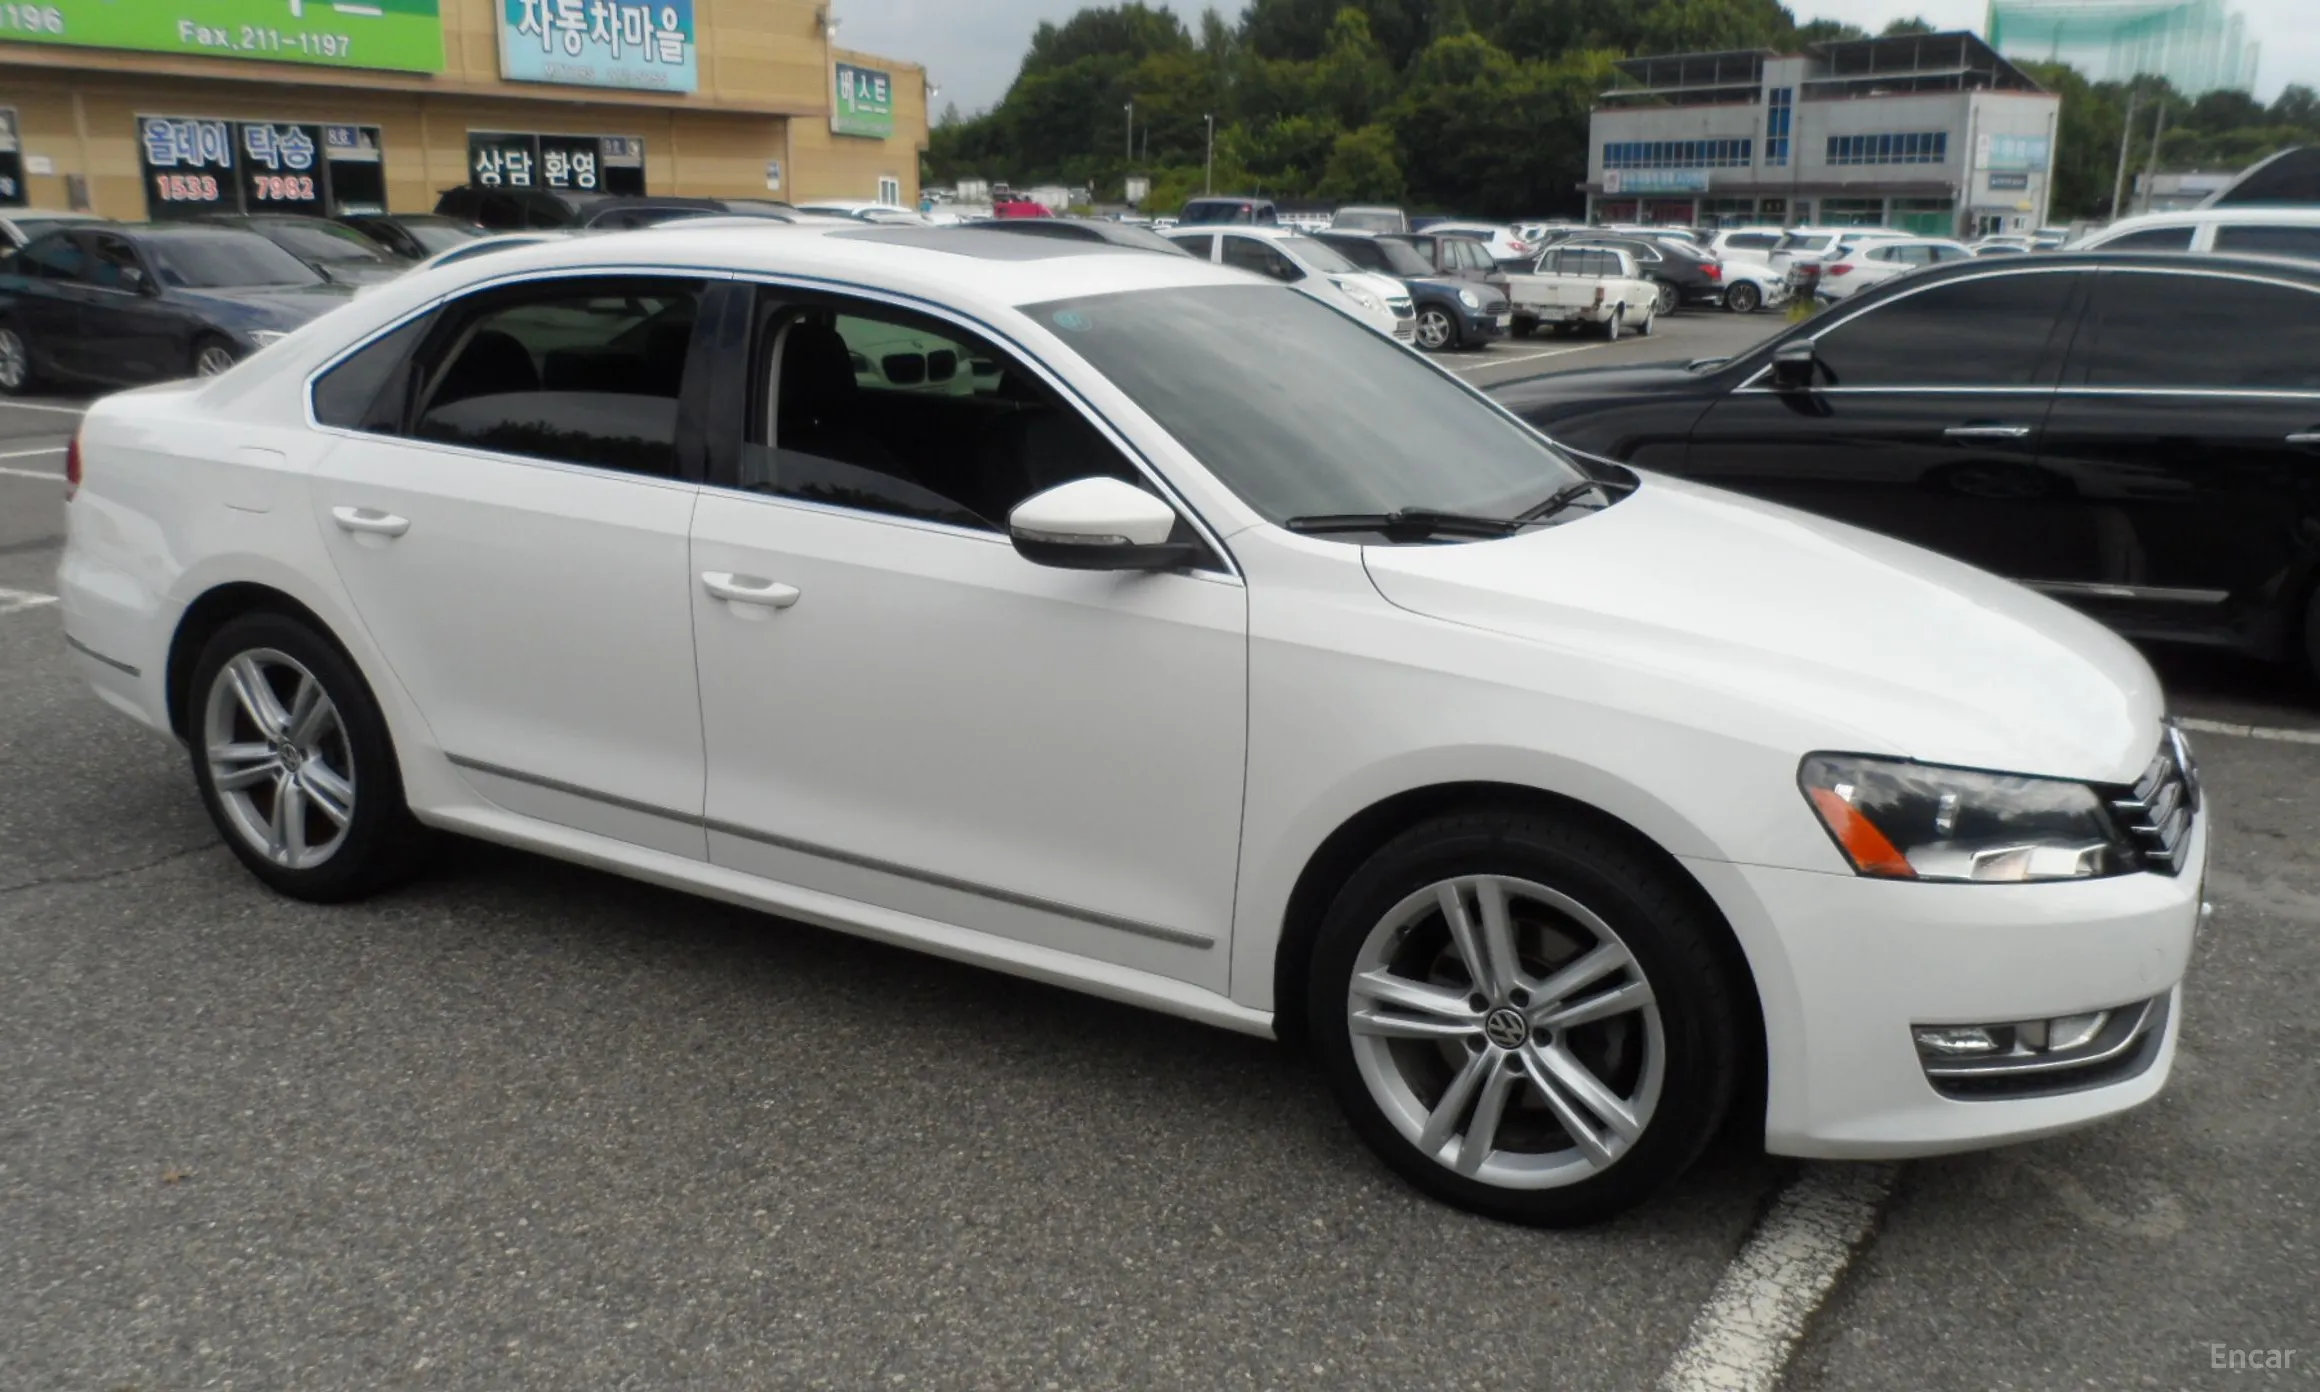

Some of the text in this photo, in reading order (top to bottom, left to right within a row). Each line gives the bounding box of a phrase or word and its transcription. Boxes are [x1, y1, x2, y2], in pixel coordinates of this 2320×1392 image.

[840, 70, 889, 114] 베스트
[144, 119, 314, 169] 올데이 탁송
[156, 175, 218, 201] 1533
[476, 148, 596, 188] 상담 환영
